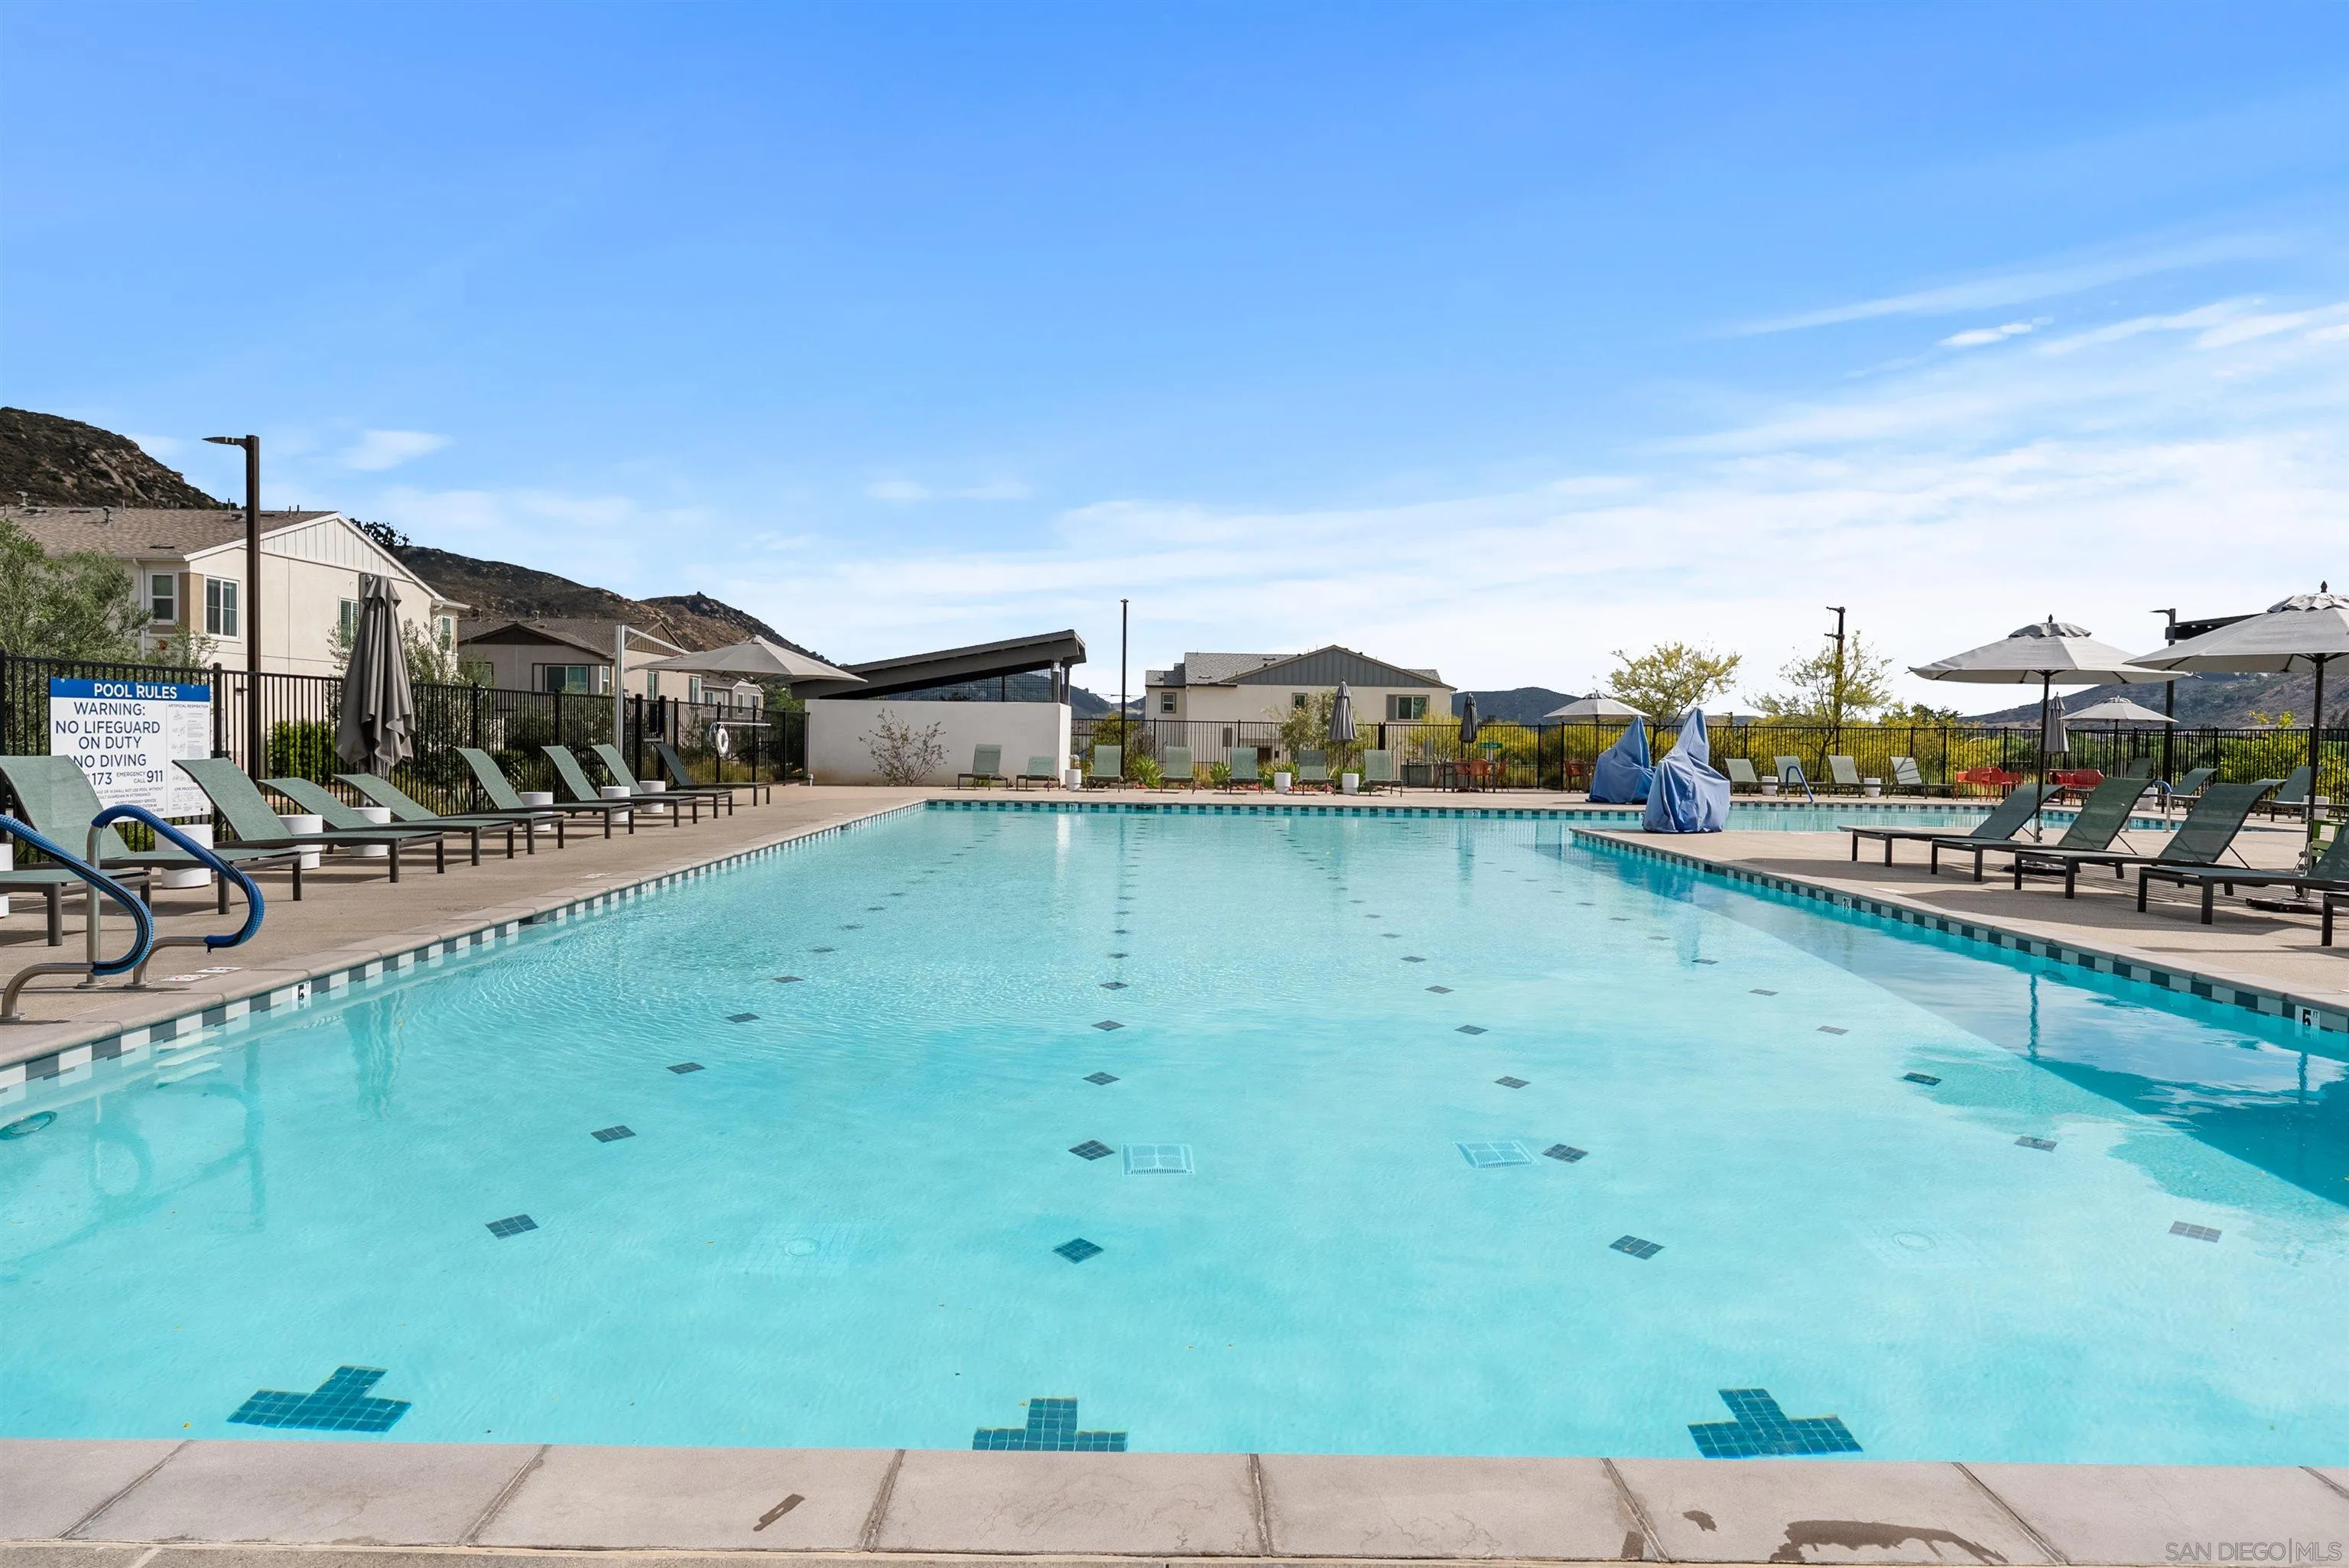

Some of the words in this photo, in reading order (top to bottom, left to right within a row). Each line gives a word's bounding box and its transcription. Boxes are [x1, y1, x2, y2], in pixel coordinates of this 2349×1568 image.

[94, 683, 133, 698] POOL
[136, 685, 177, 700] RULES
[73, 702, 145, 716] WARNING:
[56, 720, 79, 734] NO
[85, 720, 161, 734] LIFEGUARD
[79, 736, 100, 749] ON
[106, 736, 141, 749] DUTY
[73, 755, 95, 768] NO
[100, 754, 146, 768] DIVING
[92, 772, 112, 785] 173
[147, 770, 163, 783] 911
[298, 984, 304, 1000] 5
[2302, 1008, 2312, 1026] 5
